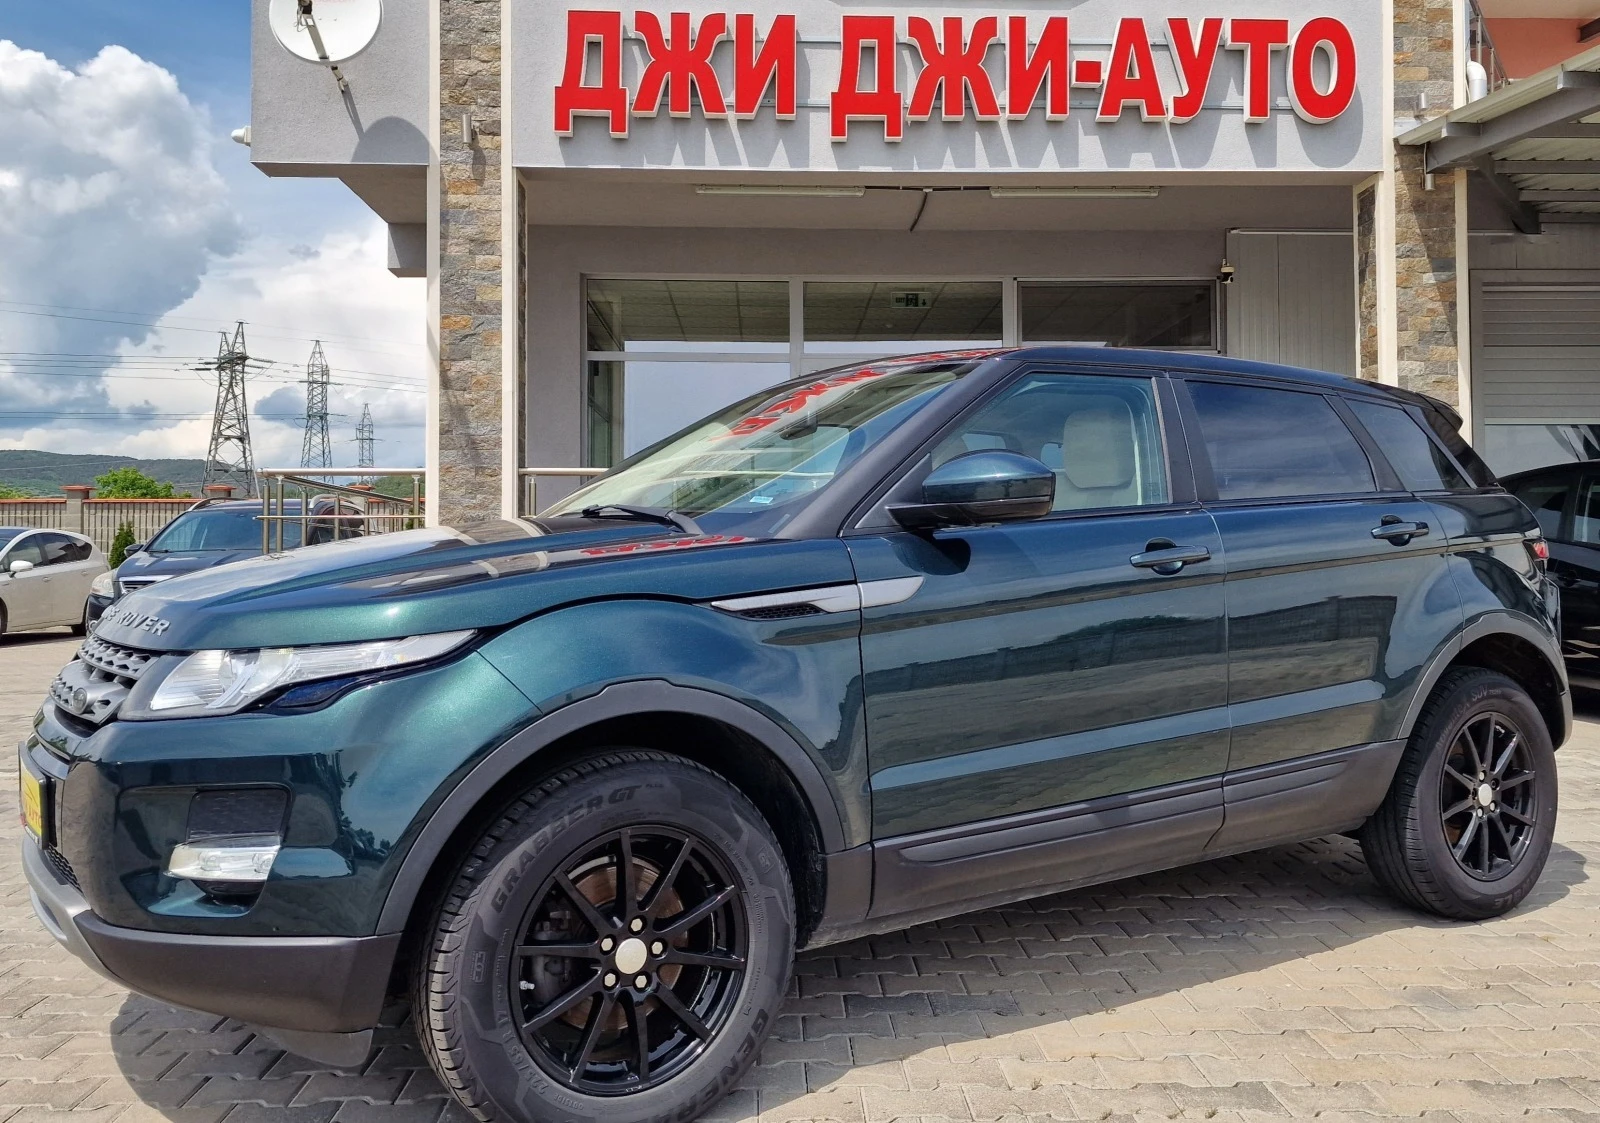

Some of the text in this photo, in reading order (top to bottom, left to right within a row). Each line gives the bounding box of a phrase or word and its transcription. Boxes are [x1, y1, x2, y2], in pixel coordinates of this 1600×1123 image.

[554, 11, 1357, 141] ДЖИ ДЖИ-АУТО
[118, 611, 171, 636] ROVER
[491, 795, 604, 913] GRABBER
[607, 785, 643, 804] GT
[664, 1008, 769, 1123] GENER
